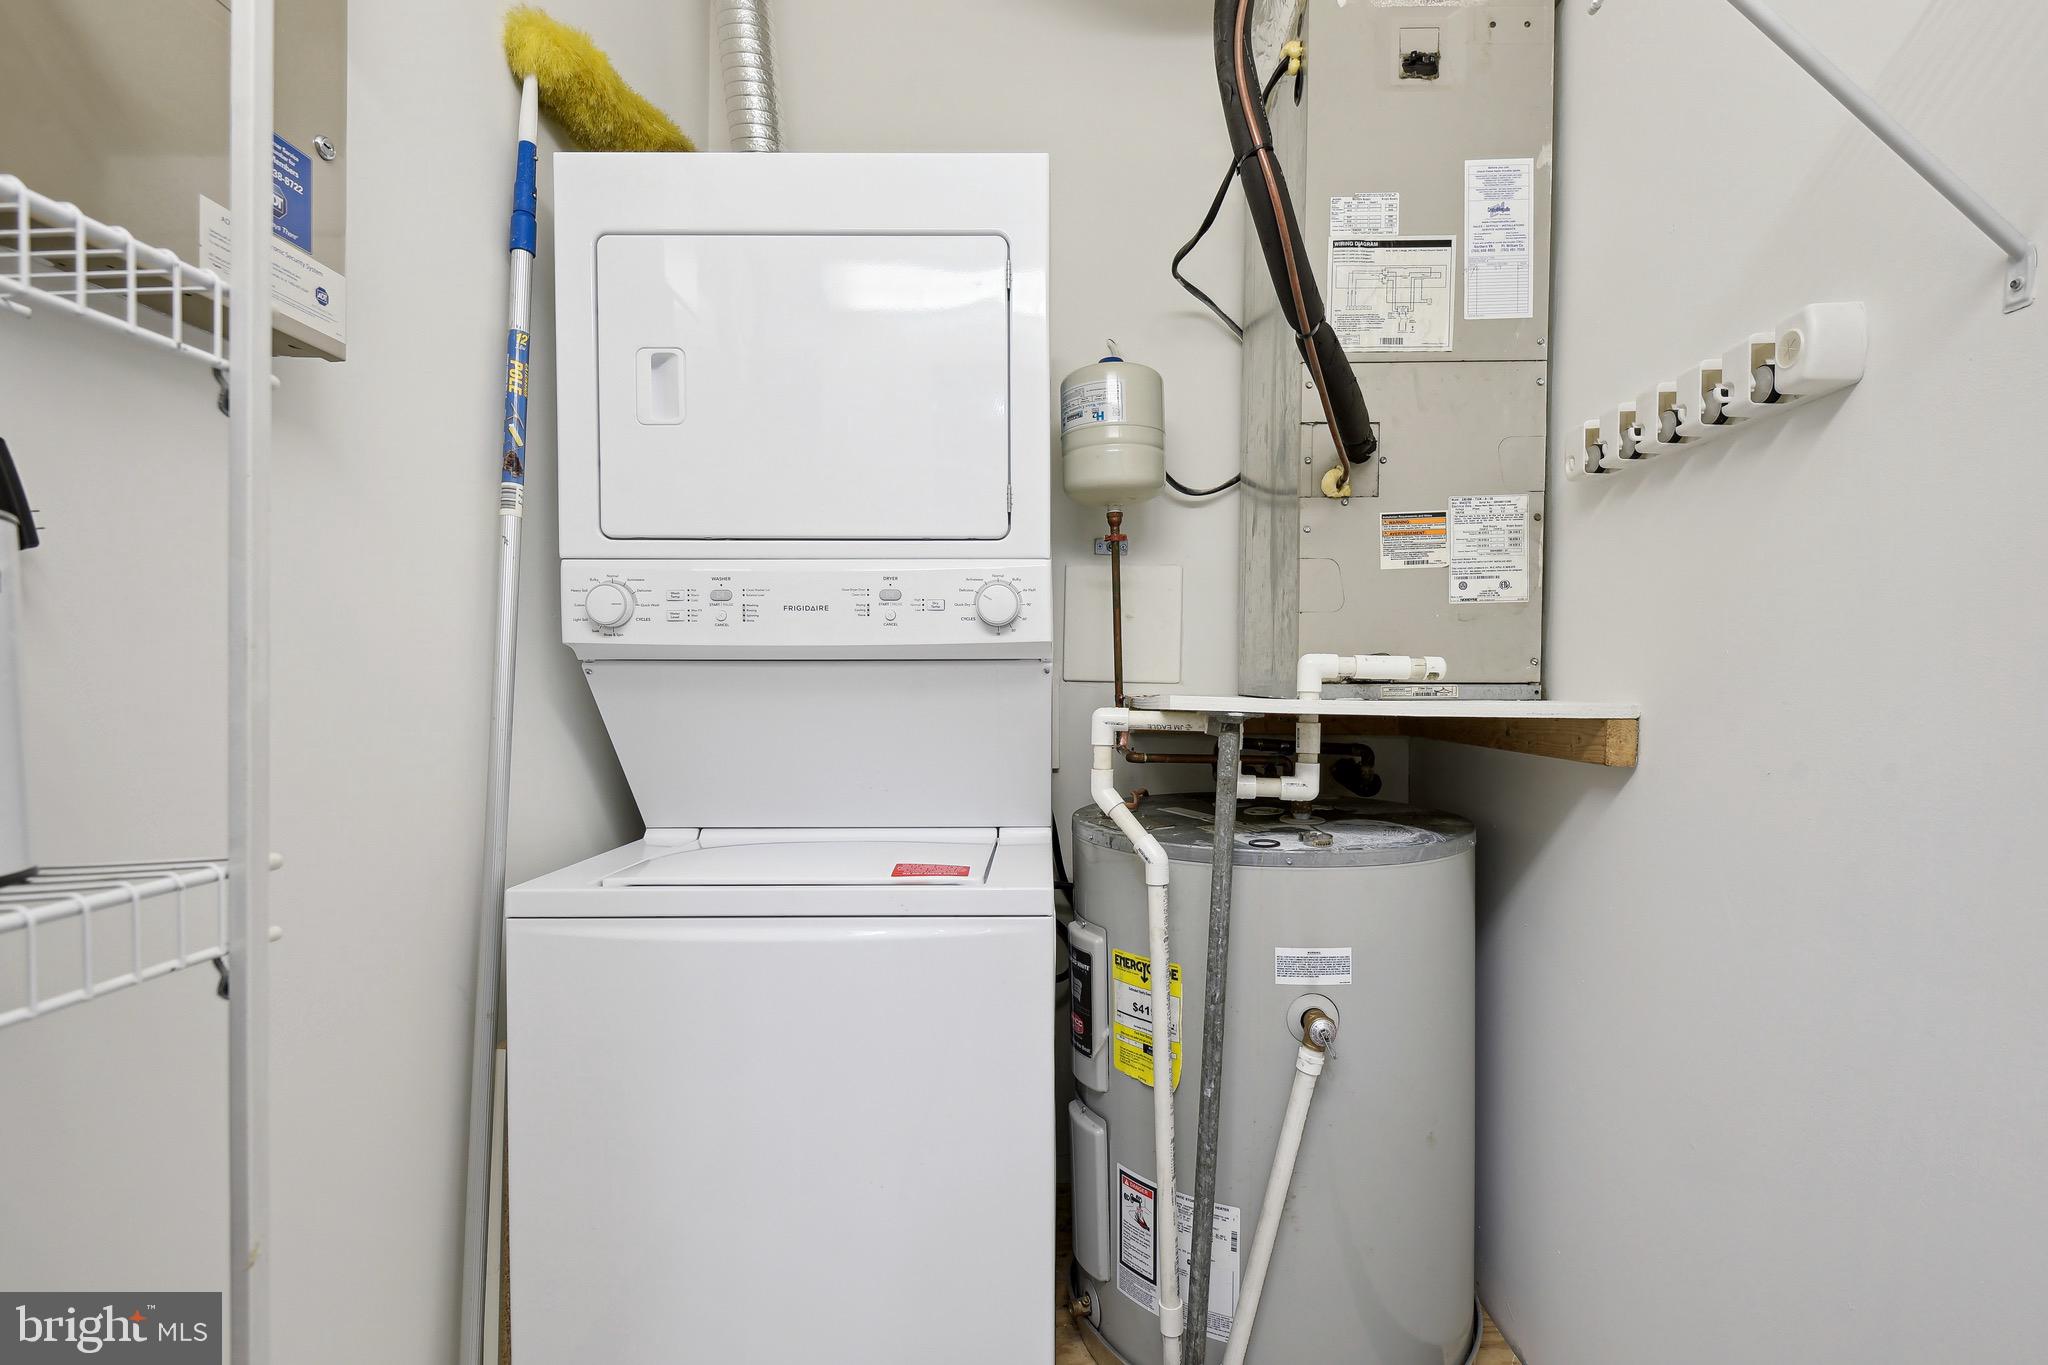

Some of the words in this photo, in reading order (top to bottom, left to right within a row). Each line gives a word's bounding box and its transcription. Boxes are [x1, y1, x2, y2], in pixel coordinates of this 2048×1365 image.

[272, 169, 304, 195] 38-8722
[509, 360, 523, 396] POLE
[783, 604, 829, 612] FRIGIDAIRE
[1132, 1002, 1152, 1017] $41
